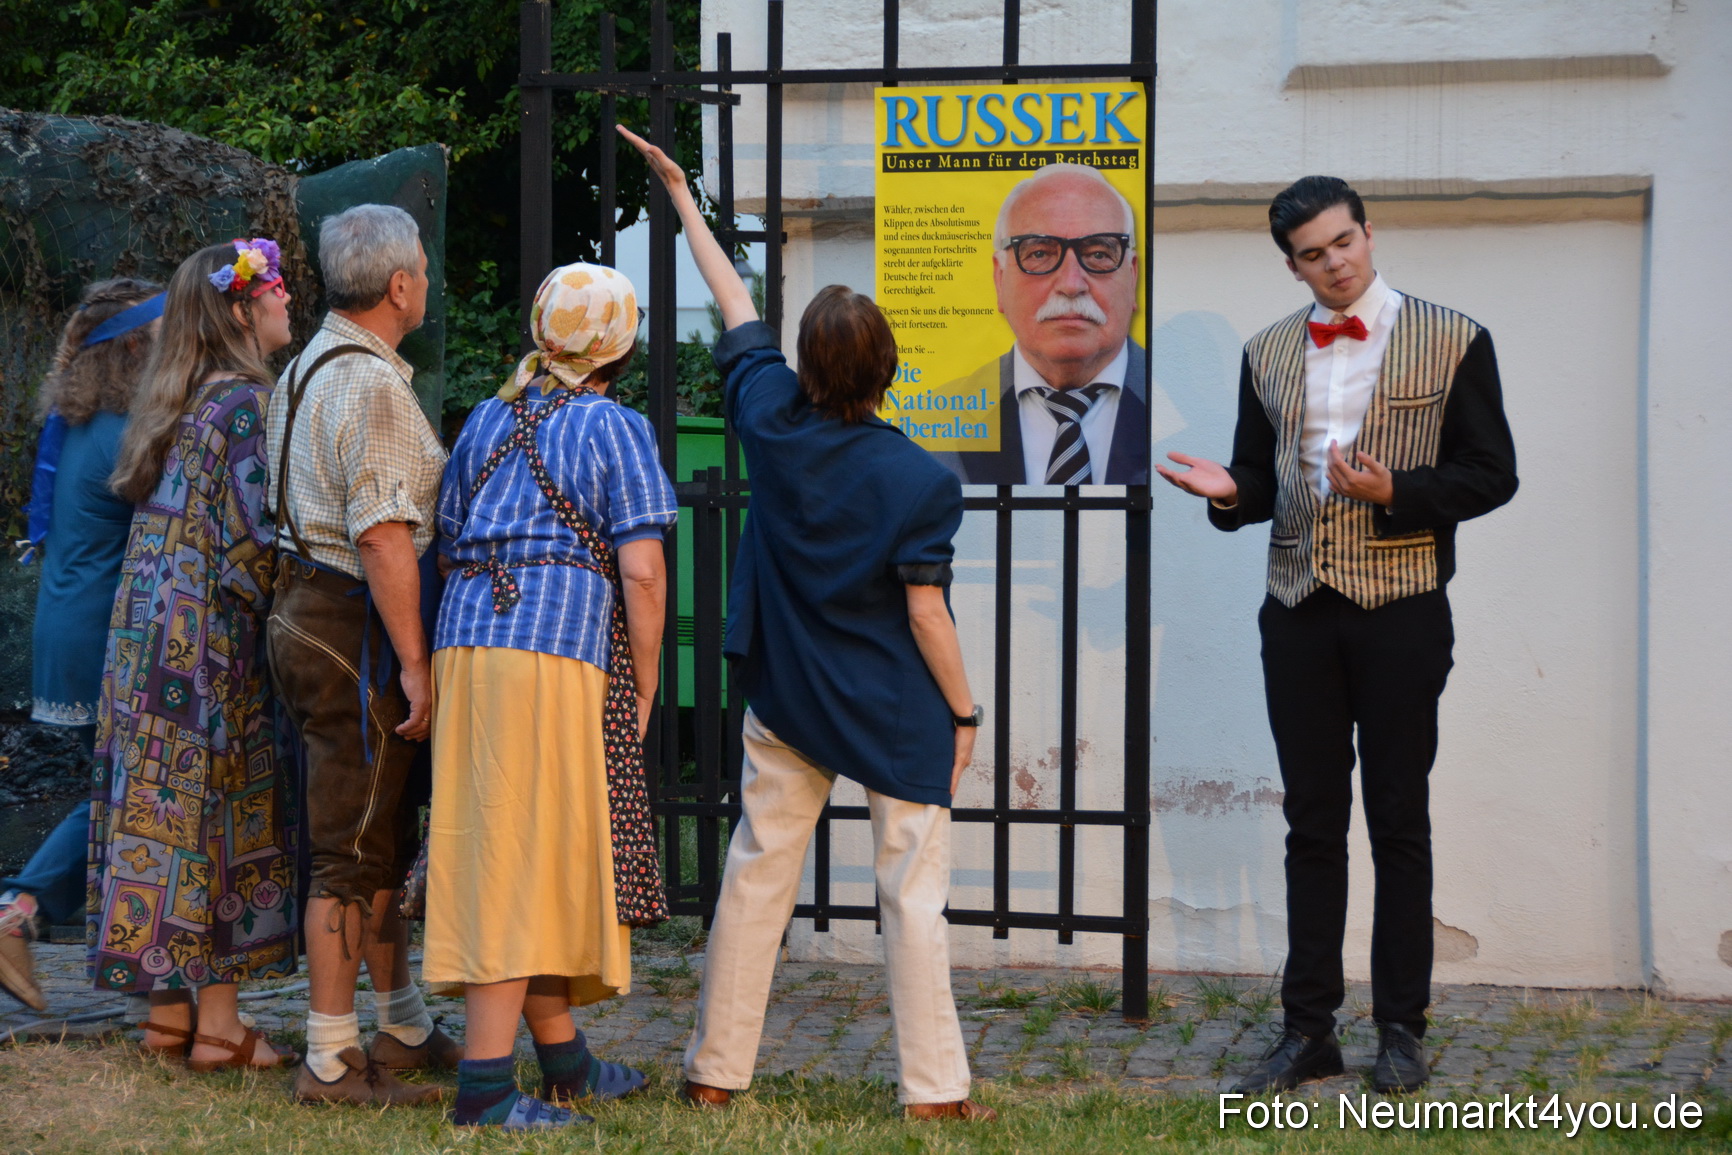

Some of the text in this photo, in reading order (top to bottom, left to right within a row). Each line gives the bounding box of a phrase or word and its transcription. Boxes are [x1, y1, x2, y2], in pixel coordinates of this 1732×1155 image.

[881, 92, 1141, 147] RUSSEK
[886, 152, 1137, 169] Unser Mann für den Reichstag
[883, 204, 965, 215] Wähler, zwischen den
[883, 218, 980, 230] Klippen des Absolutismus
[883, 231, 992, 241] und eines duckmäuserischen
[883, 245, 977, 256] sogenannten Fortschritts
[883, 258, 964, 269] strebt der aufgeklärte
[883, 272, 954, 281] Deutsche frei nach
[883, 286, 936, 296] Gerechtigkeit.
[884, 307, 909, 316] Lassen
[910, 307, 922, 315] Sie
[938, 306, 951, 315] die
[952, 306, 994, 317] begonnene
[889, 320, 948, 329] rbeit fortsetzen.
[896, 345, 913, 354] hlen
[914, 345, 926, 354] Sie
[885, 388, 996, 411] National-
